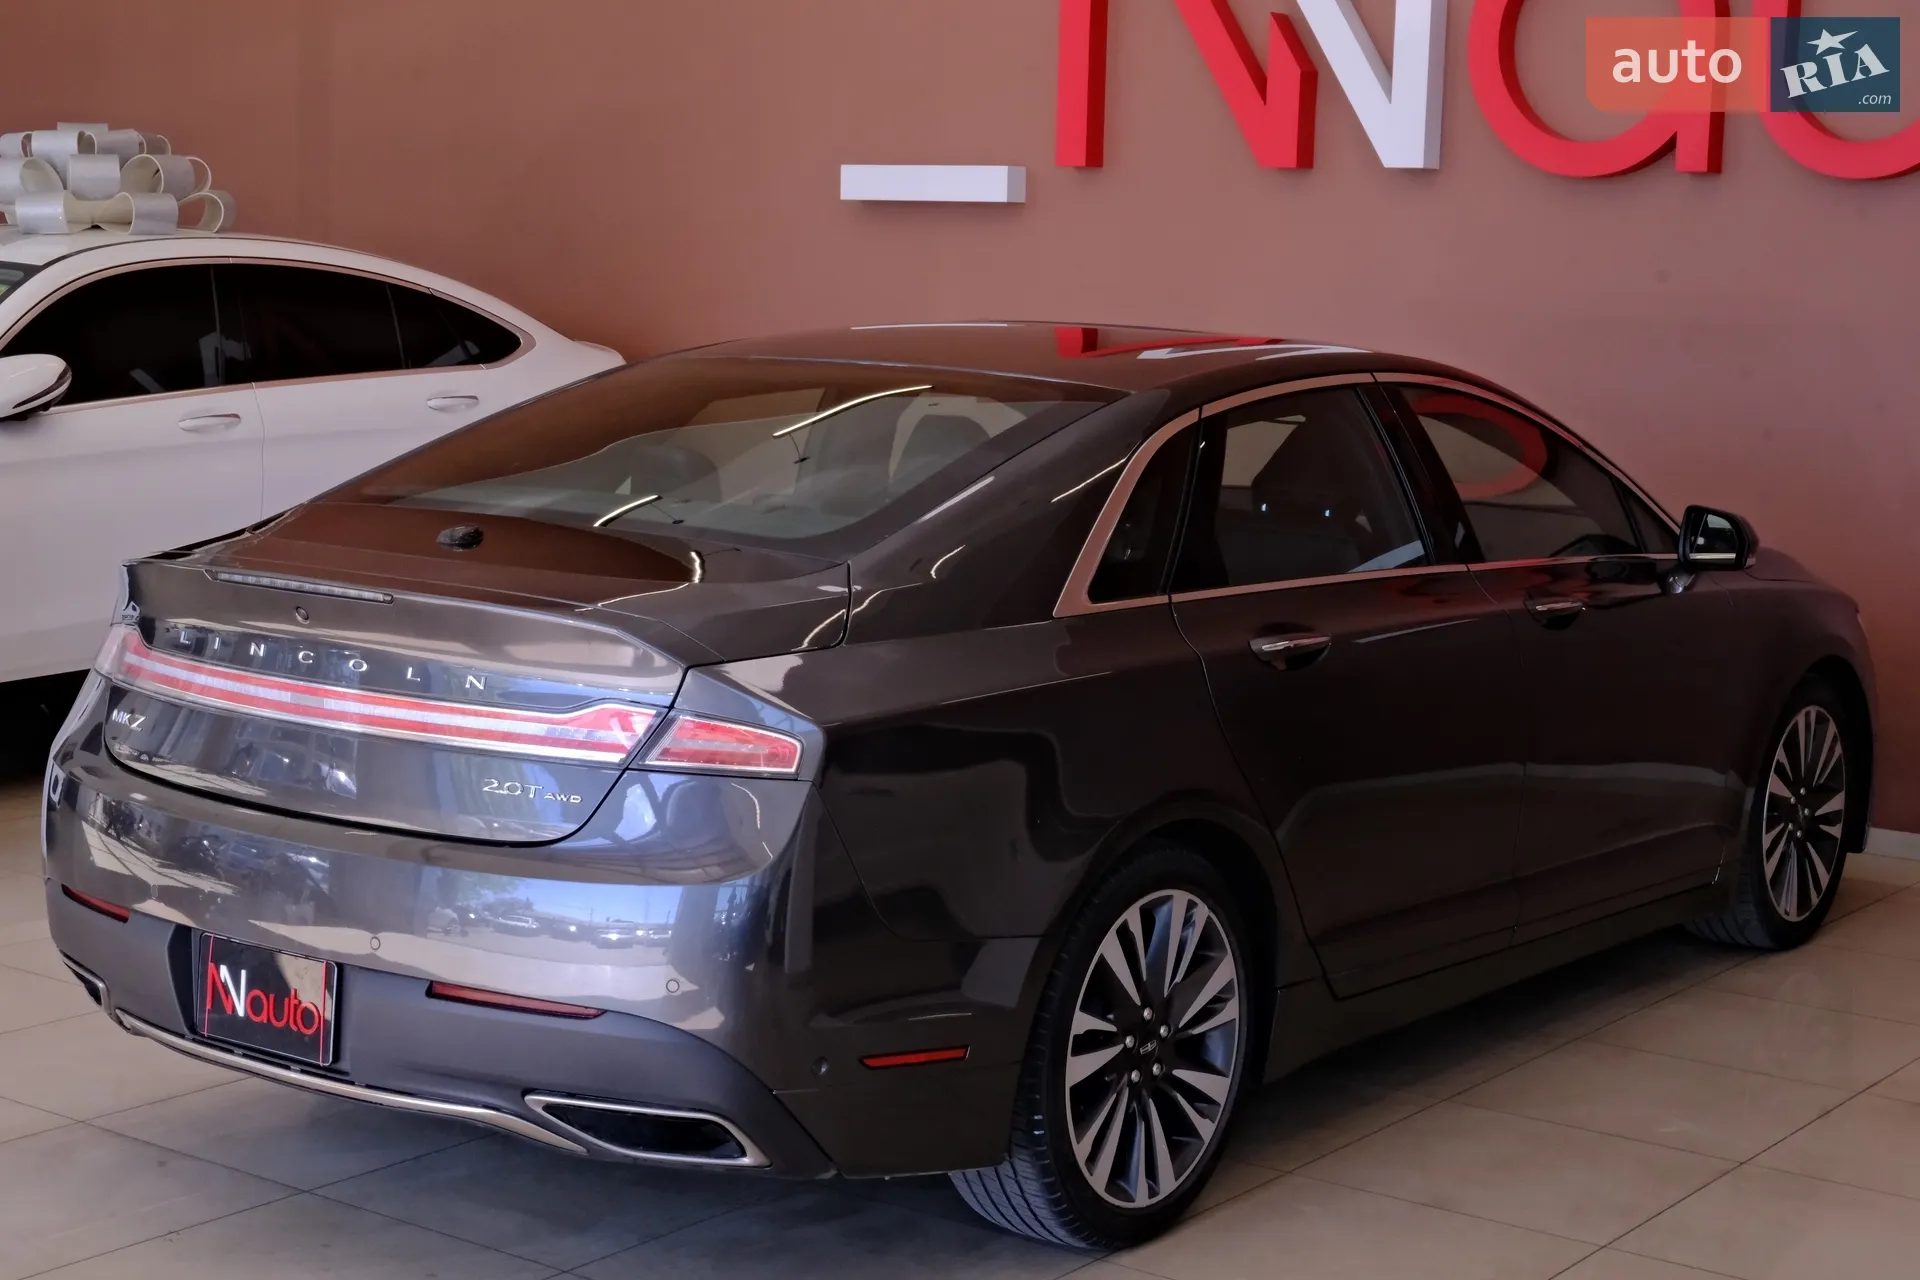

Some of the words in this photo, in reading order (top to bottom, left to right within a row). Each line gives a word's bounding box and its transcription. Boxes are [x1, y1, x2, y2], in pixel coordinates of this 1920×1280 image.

[179, 630, 487, 690] LINCOLN
[112, 708, 147, 732] MKZ
[544, 792, 582, 804] AWD
